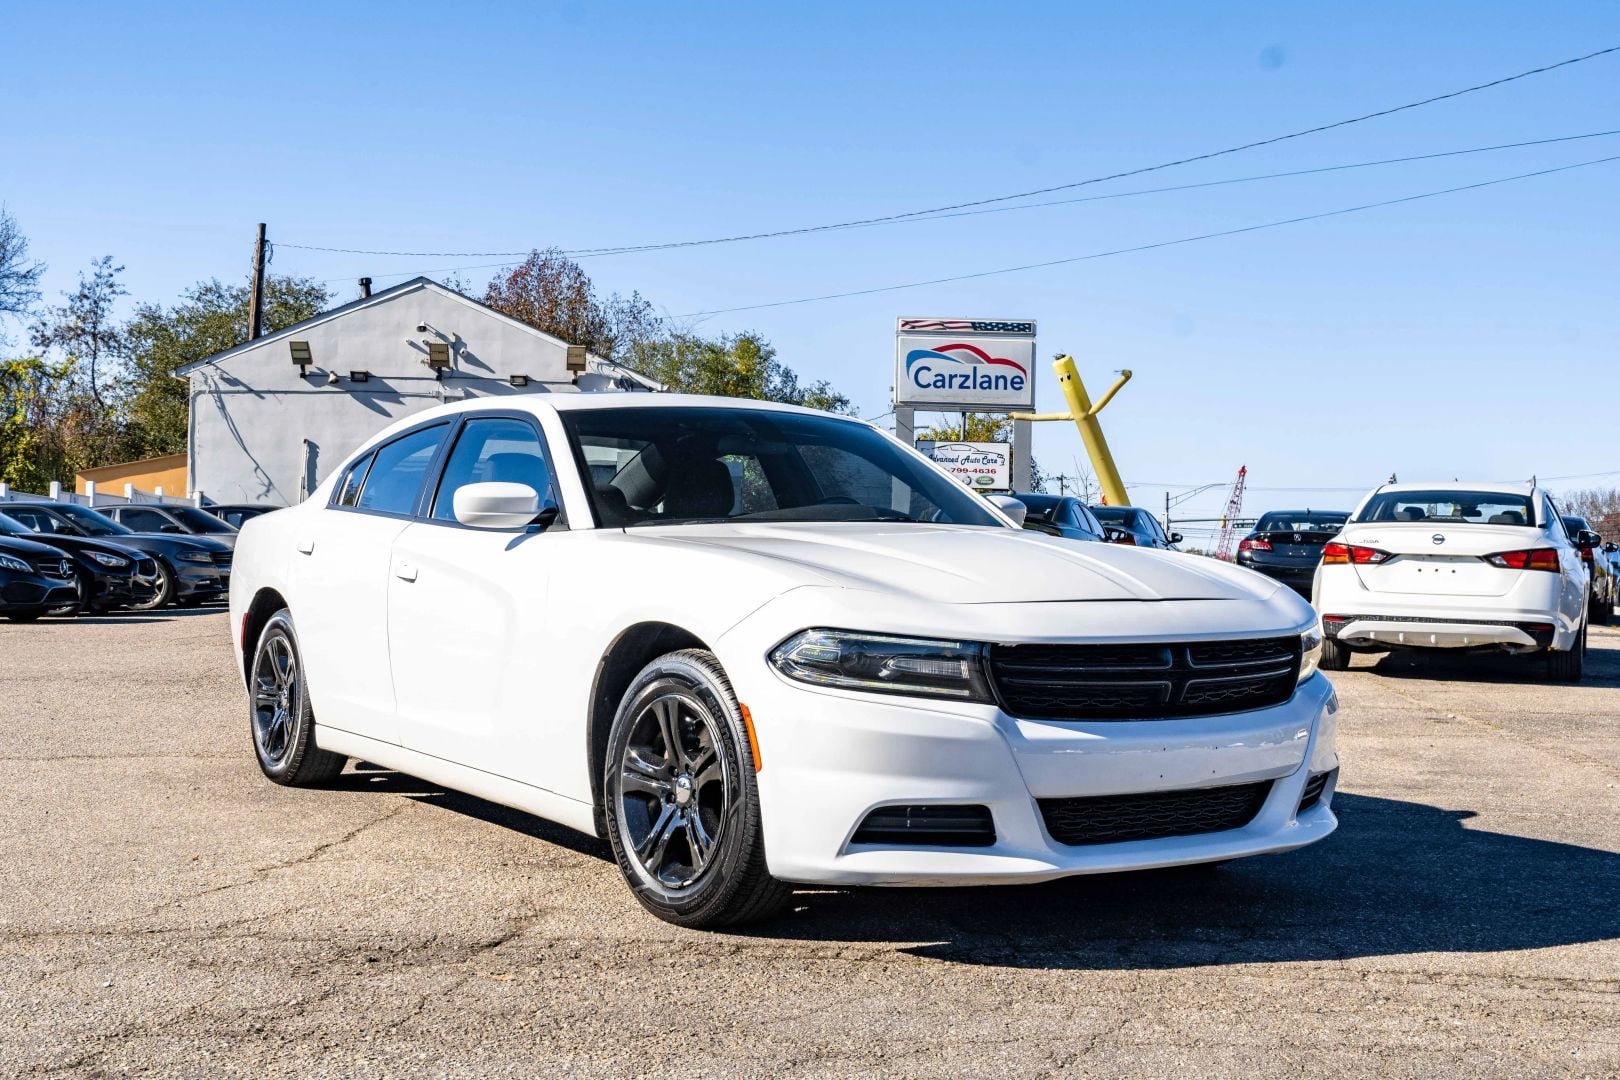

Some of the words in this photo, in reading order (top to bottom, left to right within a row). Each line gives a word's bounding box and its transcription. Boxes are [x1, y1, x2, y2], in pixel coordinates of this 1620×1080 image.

[914, 366, 1024, 391] Carzlane
[960, 455, 980, 466] Auto
[981, 456, 998, 465] Care
